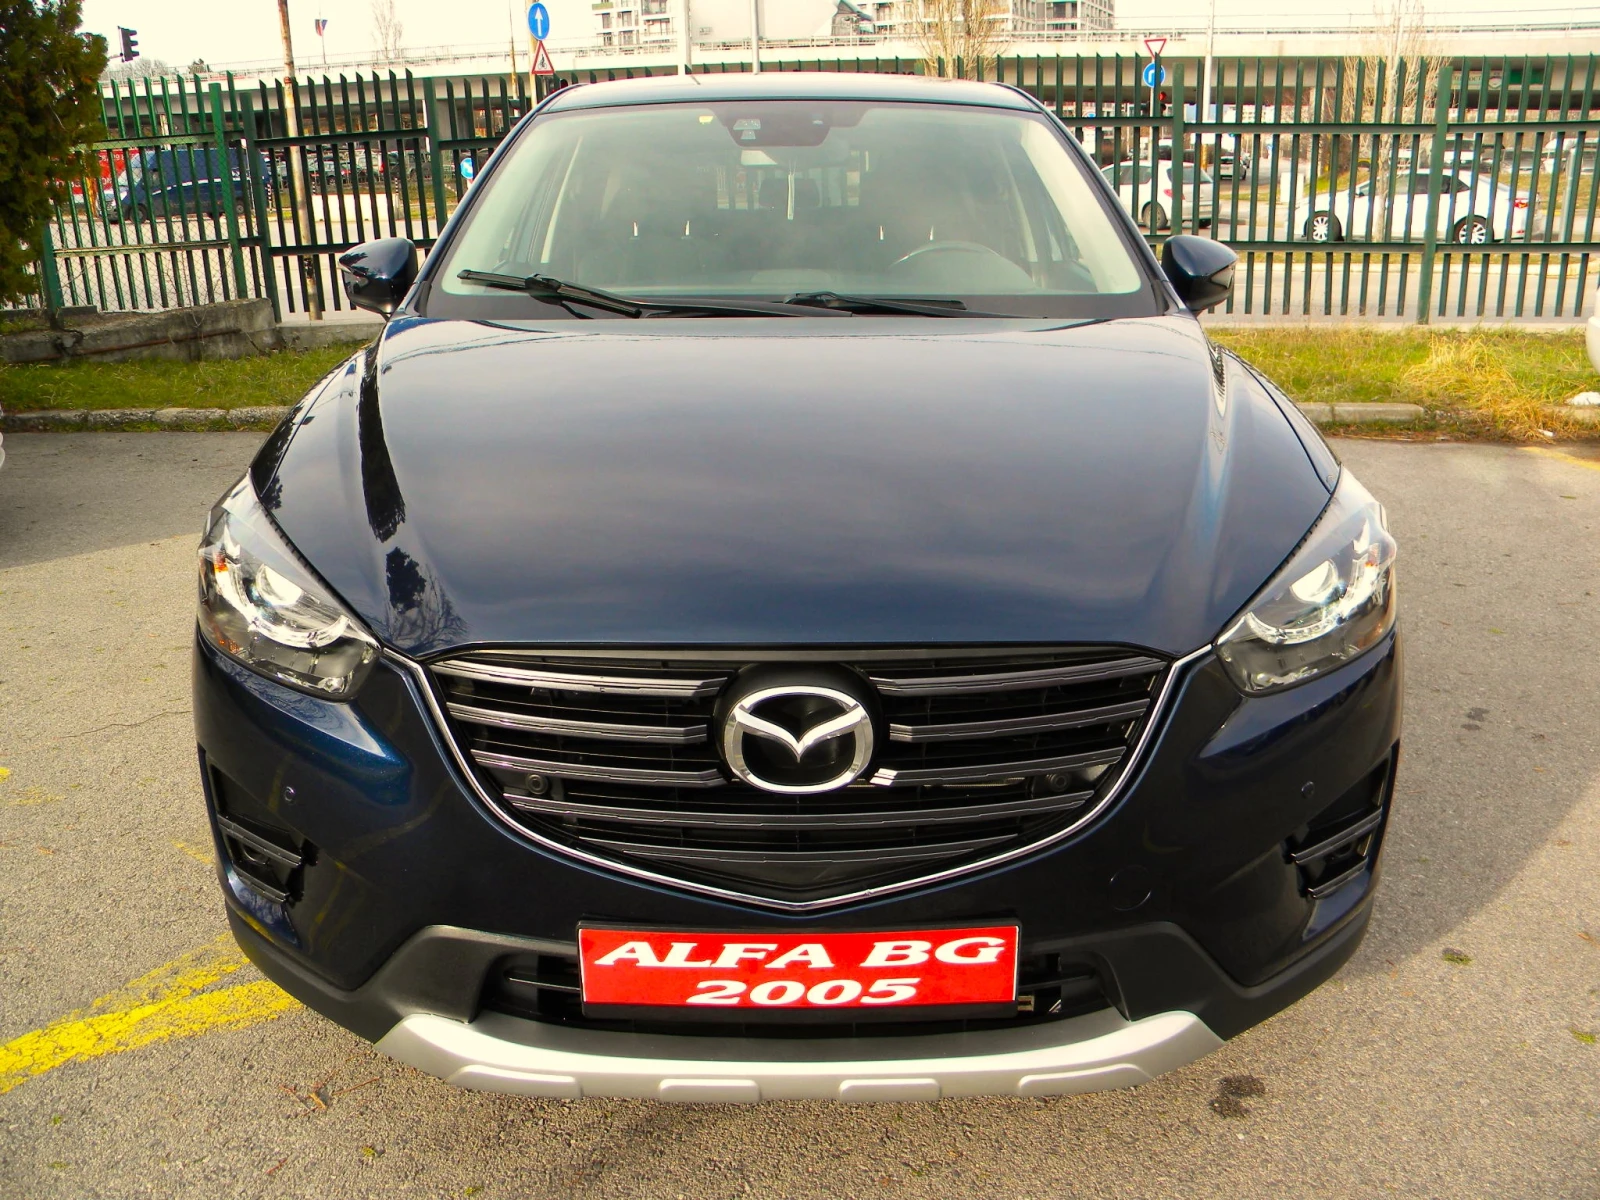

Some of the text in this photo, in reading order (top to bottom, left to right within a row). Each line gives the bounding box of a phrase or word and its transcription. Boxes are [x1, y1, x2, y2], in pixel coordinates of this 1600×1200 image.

[594, 936, 1005, 969] ALFA BG
[686, 977, 921, 1006] 2005
